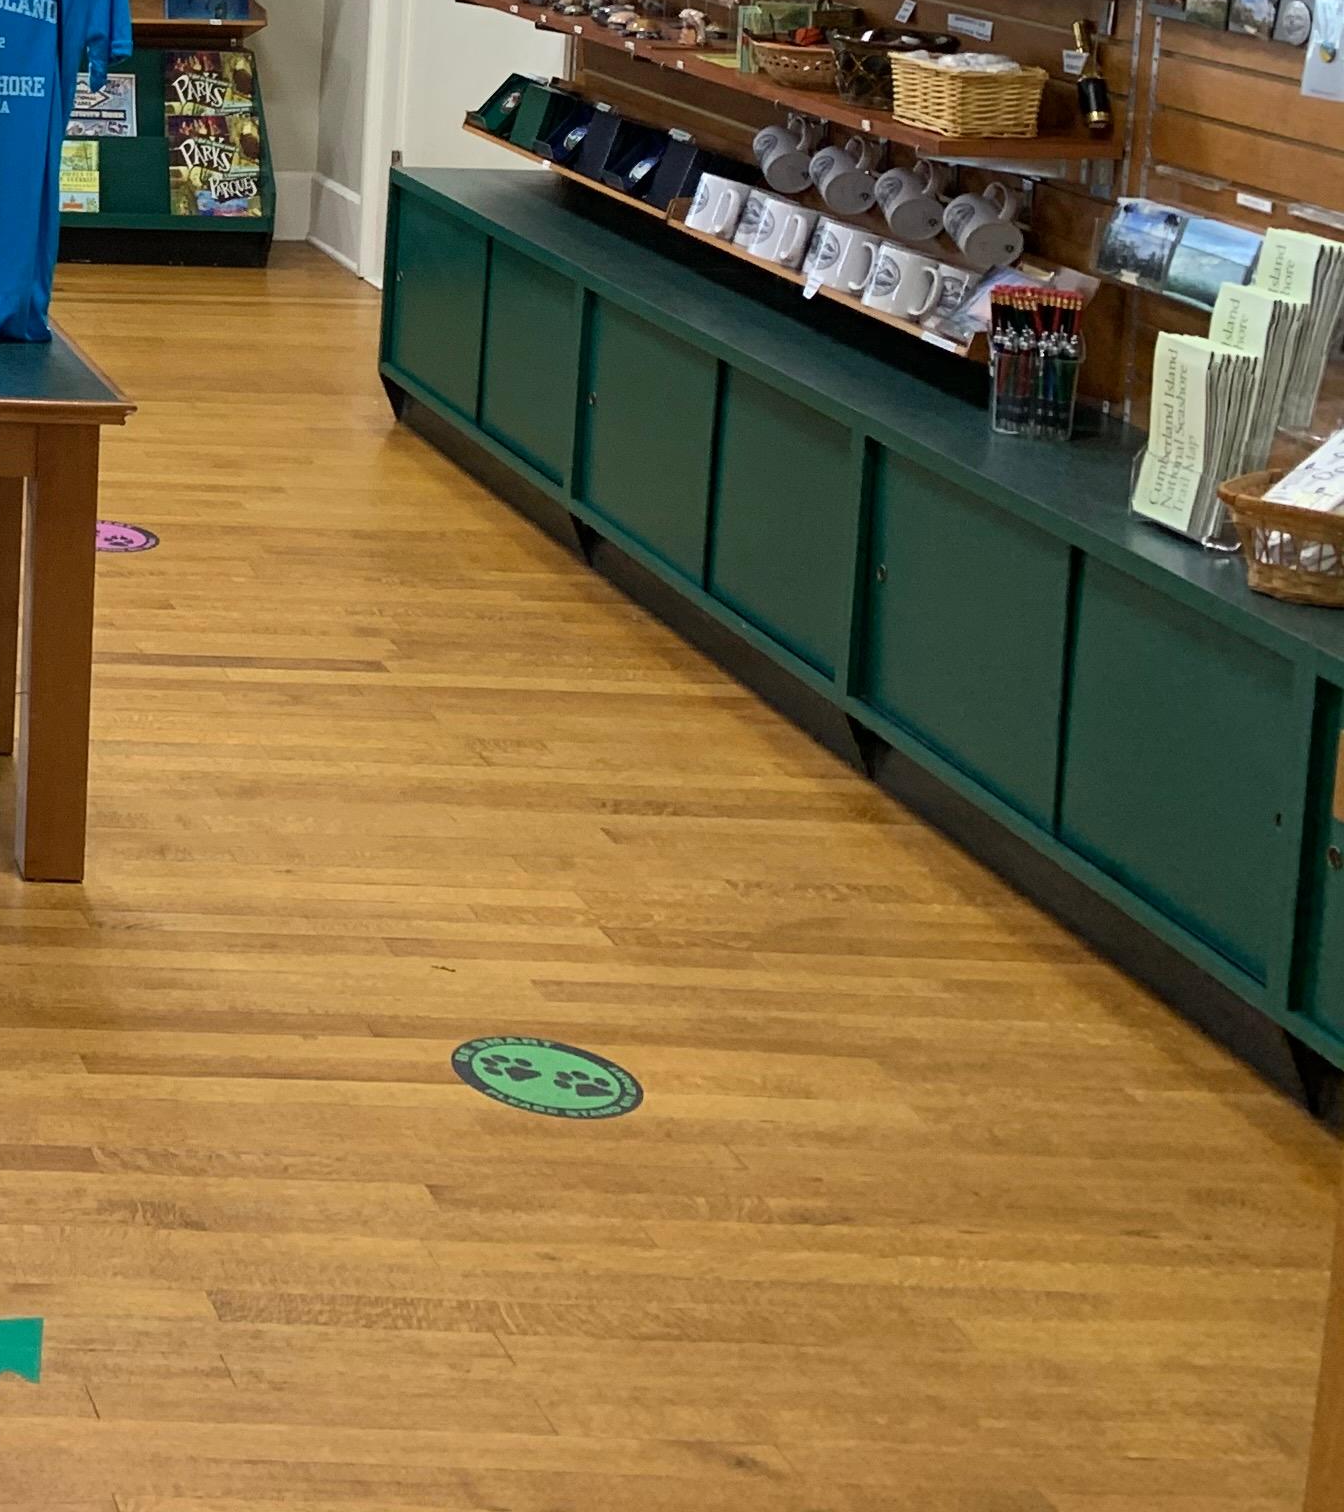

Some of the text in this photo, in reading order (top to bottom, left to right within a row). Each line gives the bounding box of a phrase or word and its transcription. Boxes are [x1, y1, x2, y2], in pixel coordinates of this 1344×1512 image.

[172, 73, 227, 109] PARKS
[179, 137, 234, 173] PARKS
[209, 176, 258, 201] PARQUES
[1267, 244, 1287, 294] Island
[1279, 259, 1296, 296] hore
[1221, 298, 1241, 347] Island
[1233, 313, 1249, 351] hore
[1149, 348, 1179, 506] Cumberland Island
[1160, 364, 1189, 509] National Seashore
[1172, 475, 1190, 512] Trail
